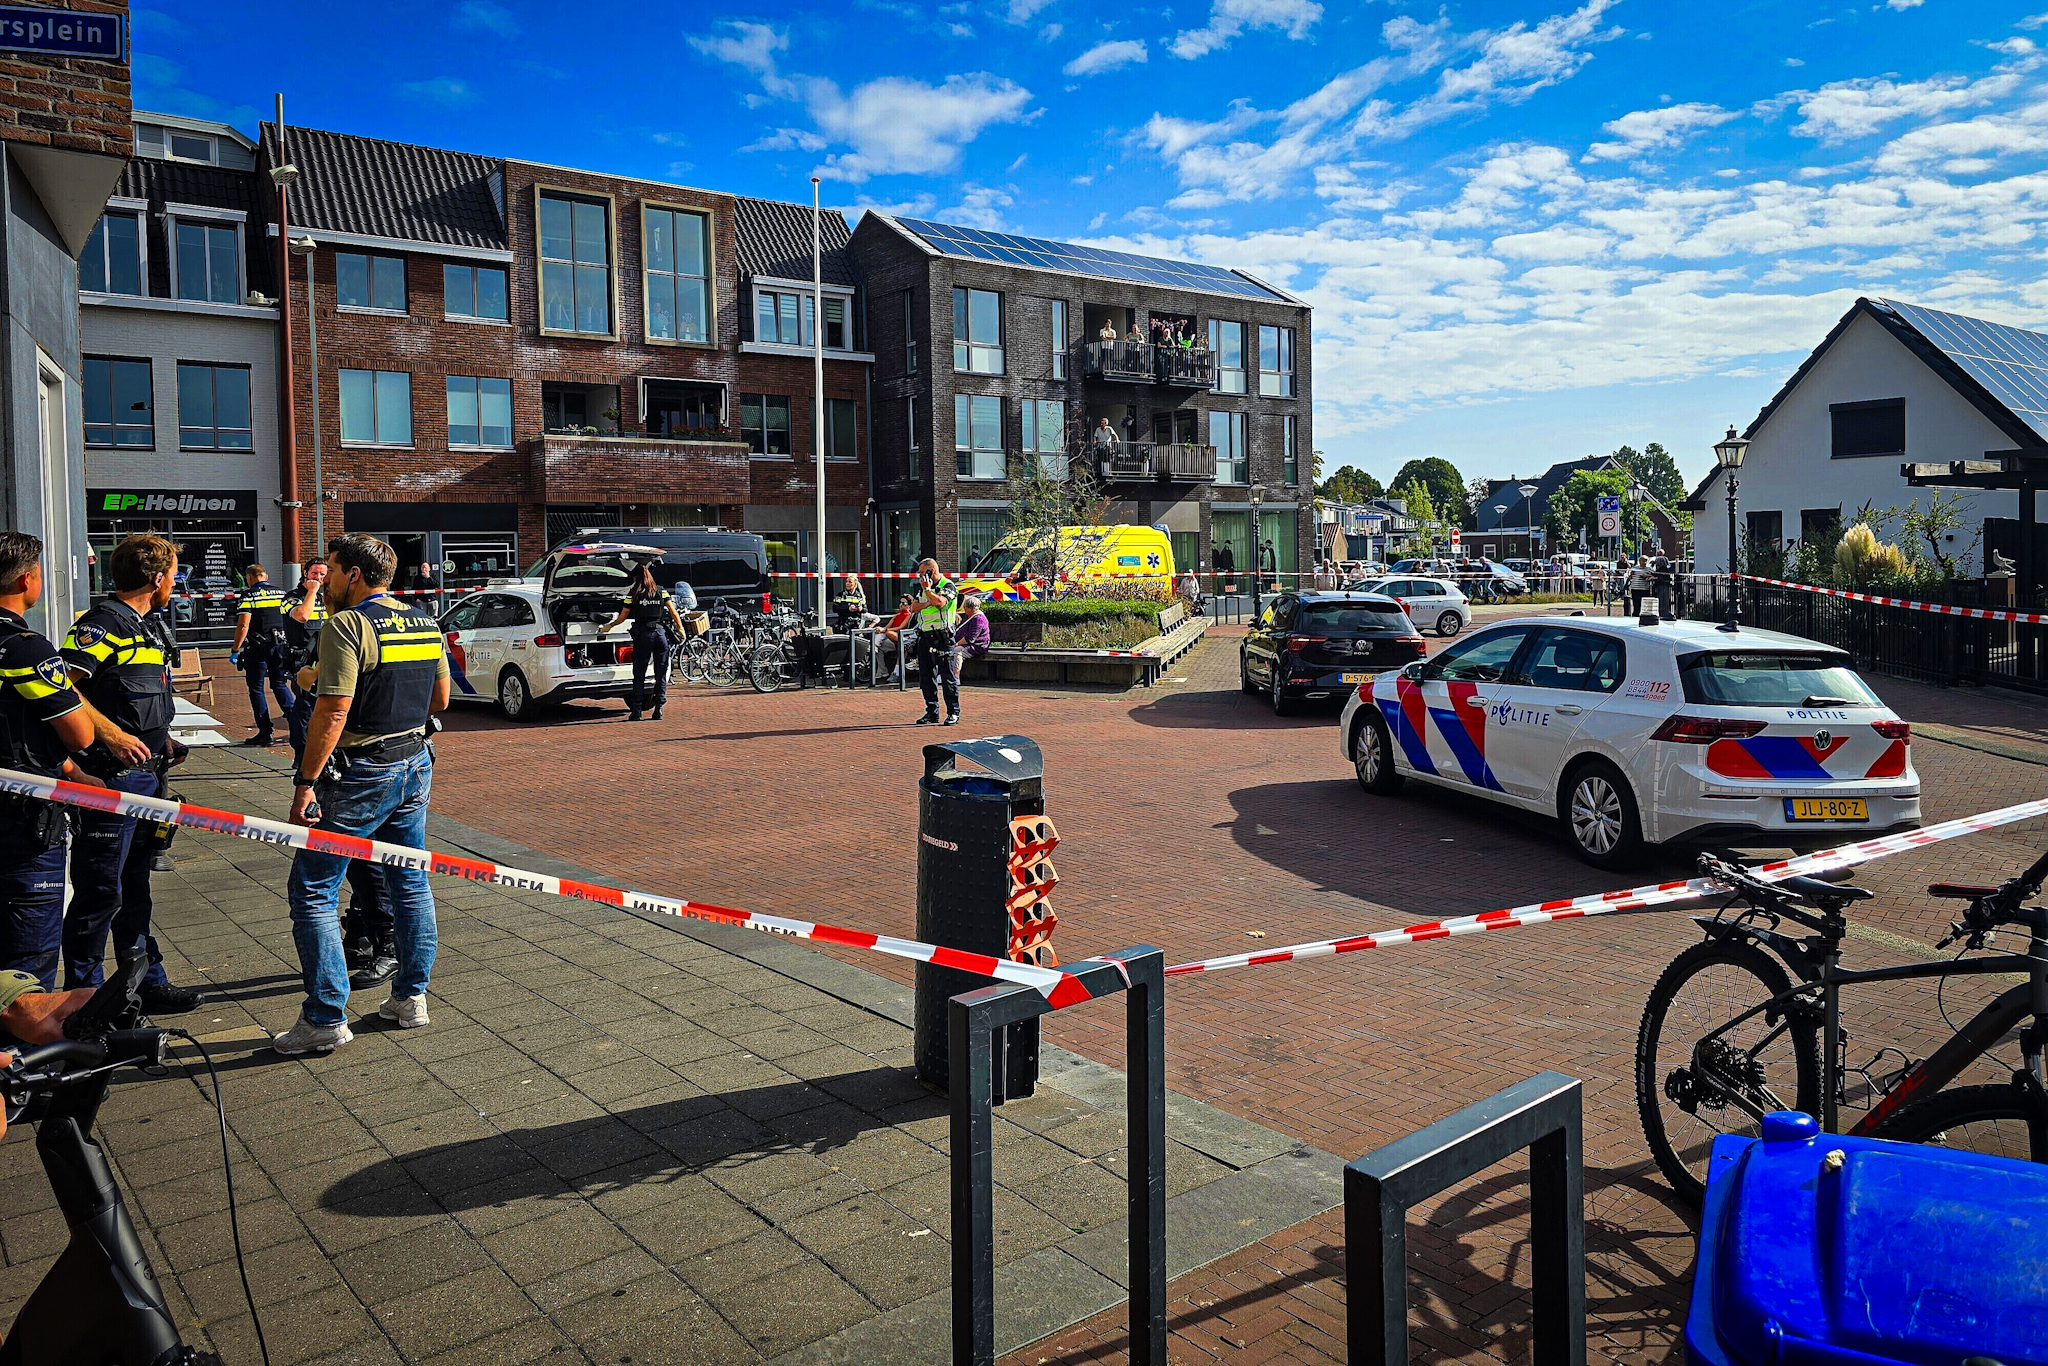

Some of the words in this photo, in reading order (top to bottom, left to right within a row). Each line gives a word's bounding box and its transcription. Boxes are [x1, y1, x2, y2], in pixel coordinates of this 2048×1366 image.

[103, 494, 236, 514] EP:Heijnen
[385, 611, 434, 632] POLITIE
[467, 647, 490, 662] POLITIE
[1650, 682, 1671, 694] 112
[1491, 696, 1550, 726] POLITIE
[1787, 710, 1848, 720] POLITIE
[1801, 801, 1860, 816] JLJ-80-Z
